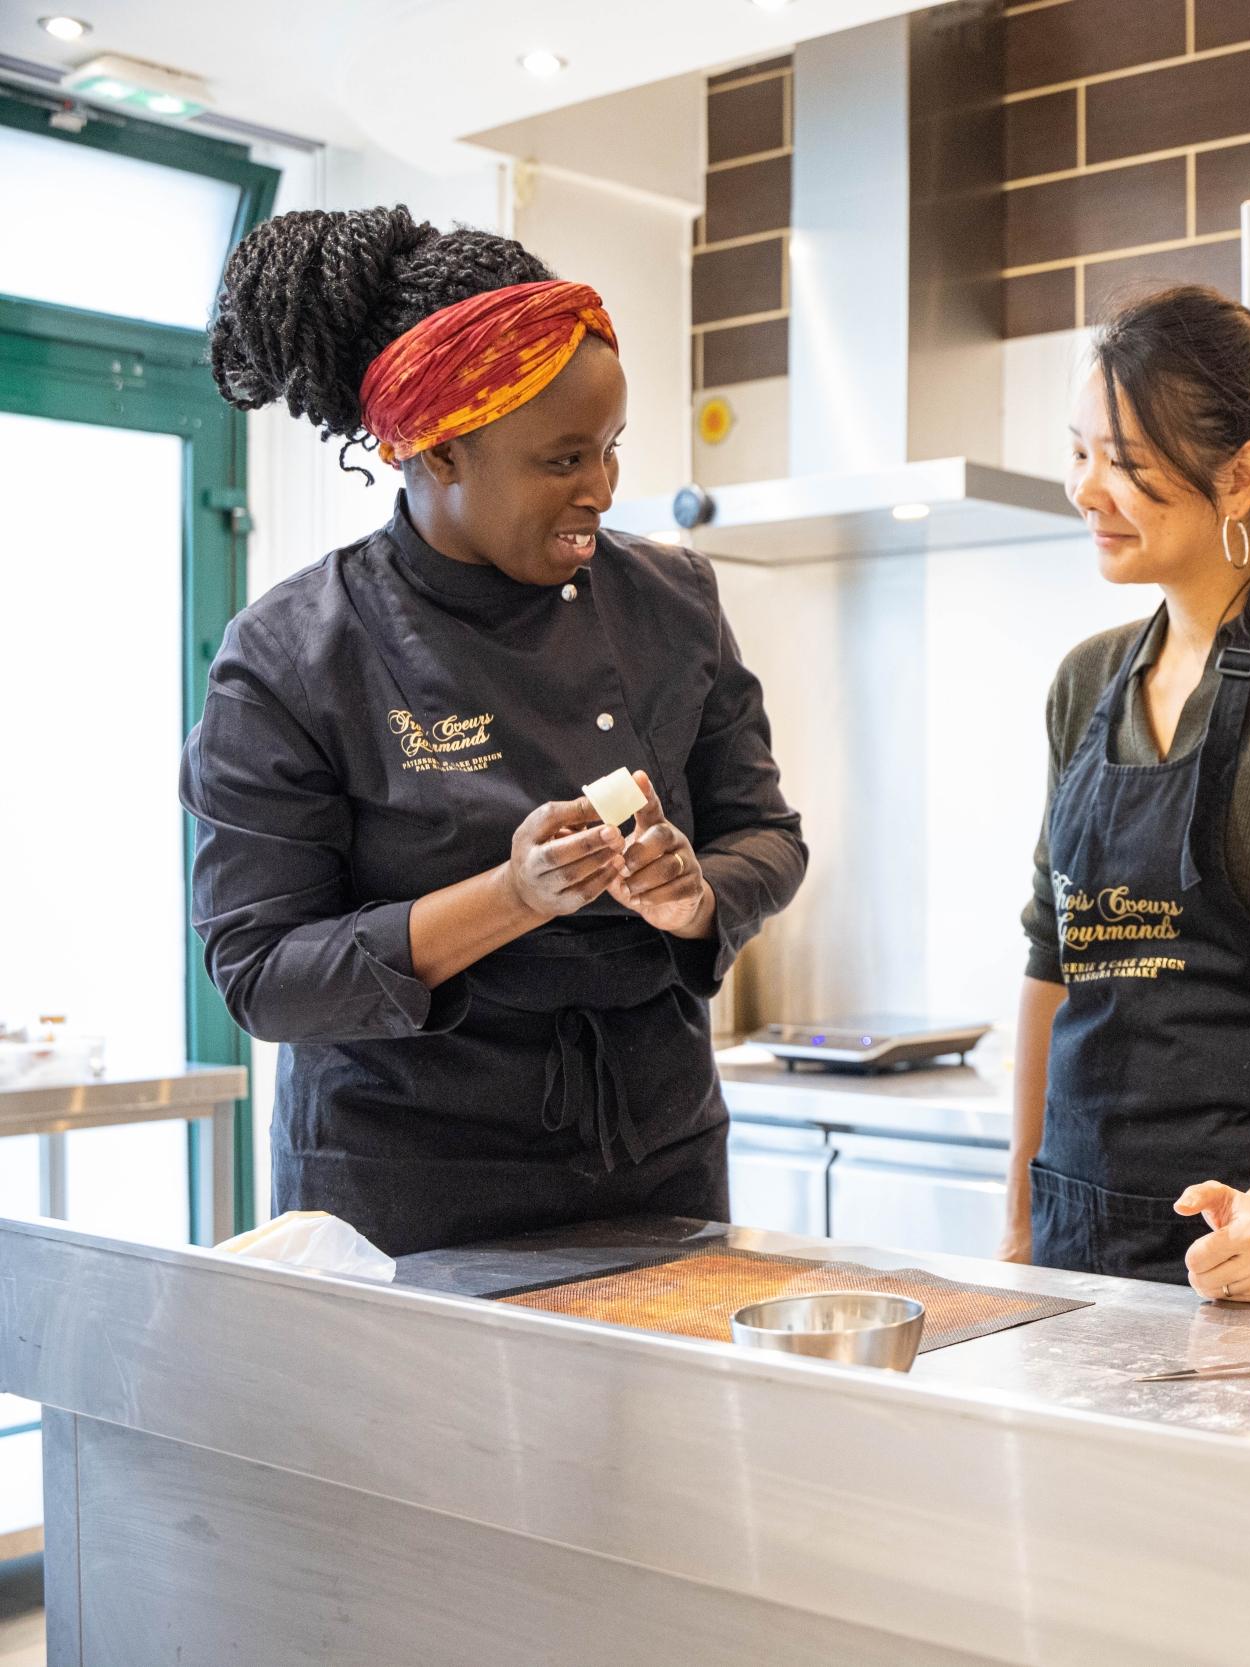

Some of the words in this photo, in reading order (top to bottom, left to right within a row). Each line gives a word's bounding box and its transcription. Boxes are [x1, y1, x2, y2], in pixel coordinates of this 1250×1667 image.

[401, 726, 490, 757] Gormands
[472, 752, 502, 764] DESIGN
[415, 763, 431, 772] PAR
[1097, 885, 1184, 923] Coeurs
[1062, 962, 1095, 973] SERIE
[1108, 957, 1137, 969] CAKE
[1138, 956, 1185, 971] DESIGN
[1074, 969, 1110, 983] NASSIRA
